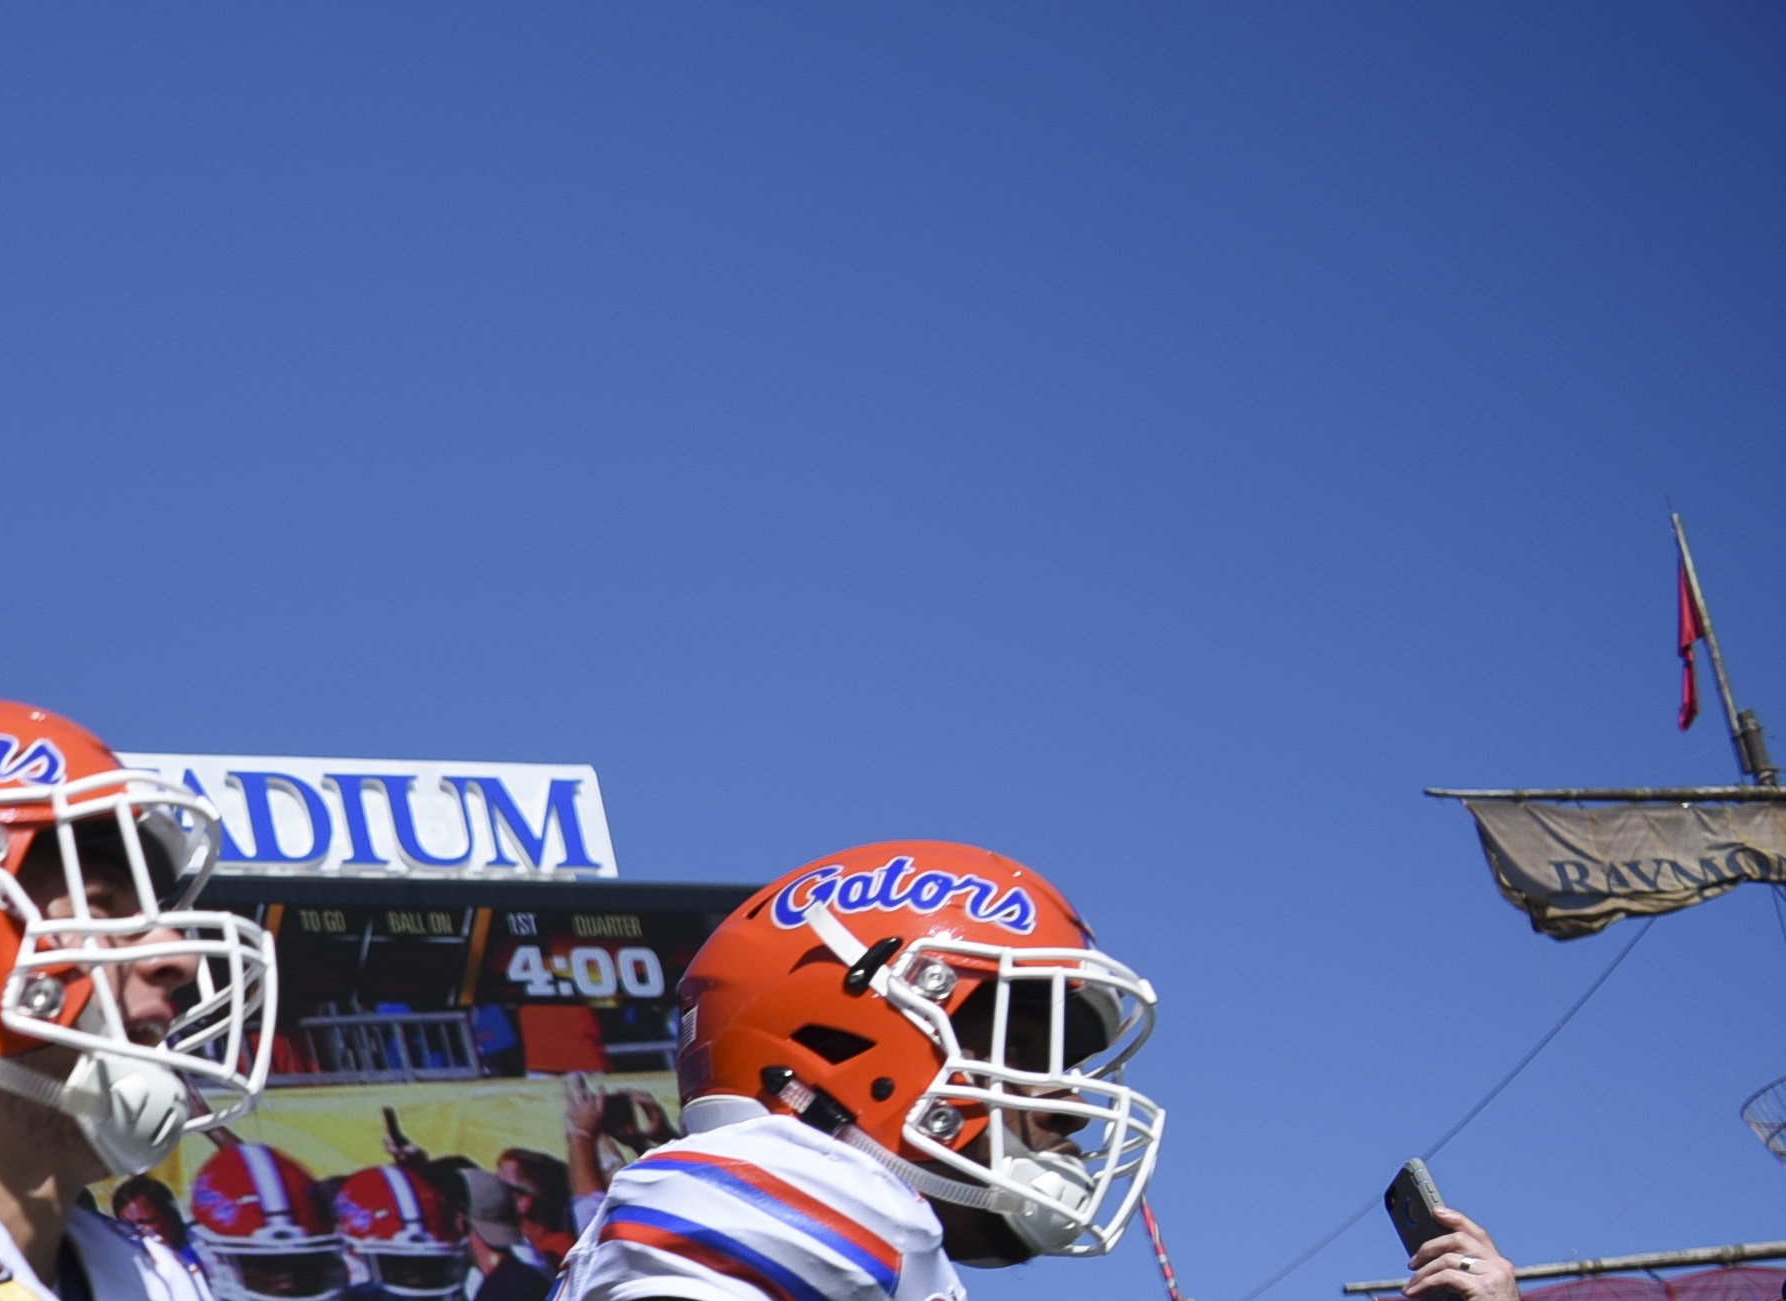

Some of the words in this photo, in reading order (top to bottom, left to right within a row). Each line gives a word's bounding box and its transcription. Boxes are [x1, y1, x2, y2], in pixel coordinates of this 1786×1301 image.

[162, 768, 604, 873] ADIUM
[771, 856, 1035, 934] Gators
[300, 911, 321, 933] TO
[323, 911, 347, 934] GO
[387, 911, 427, 935] BALL
[430, 913, 454, 937] ON
[507, 912, 538, 937] 1ST
[573, 914, 642, 938] QUARTER
[507, 946, 665, 997] 4:00
